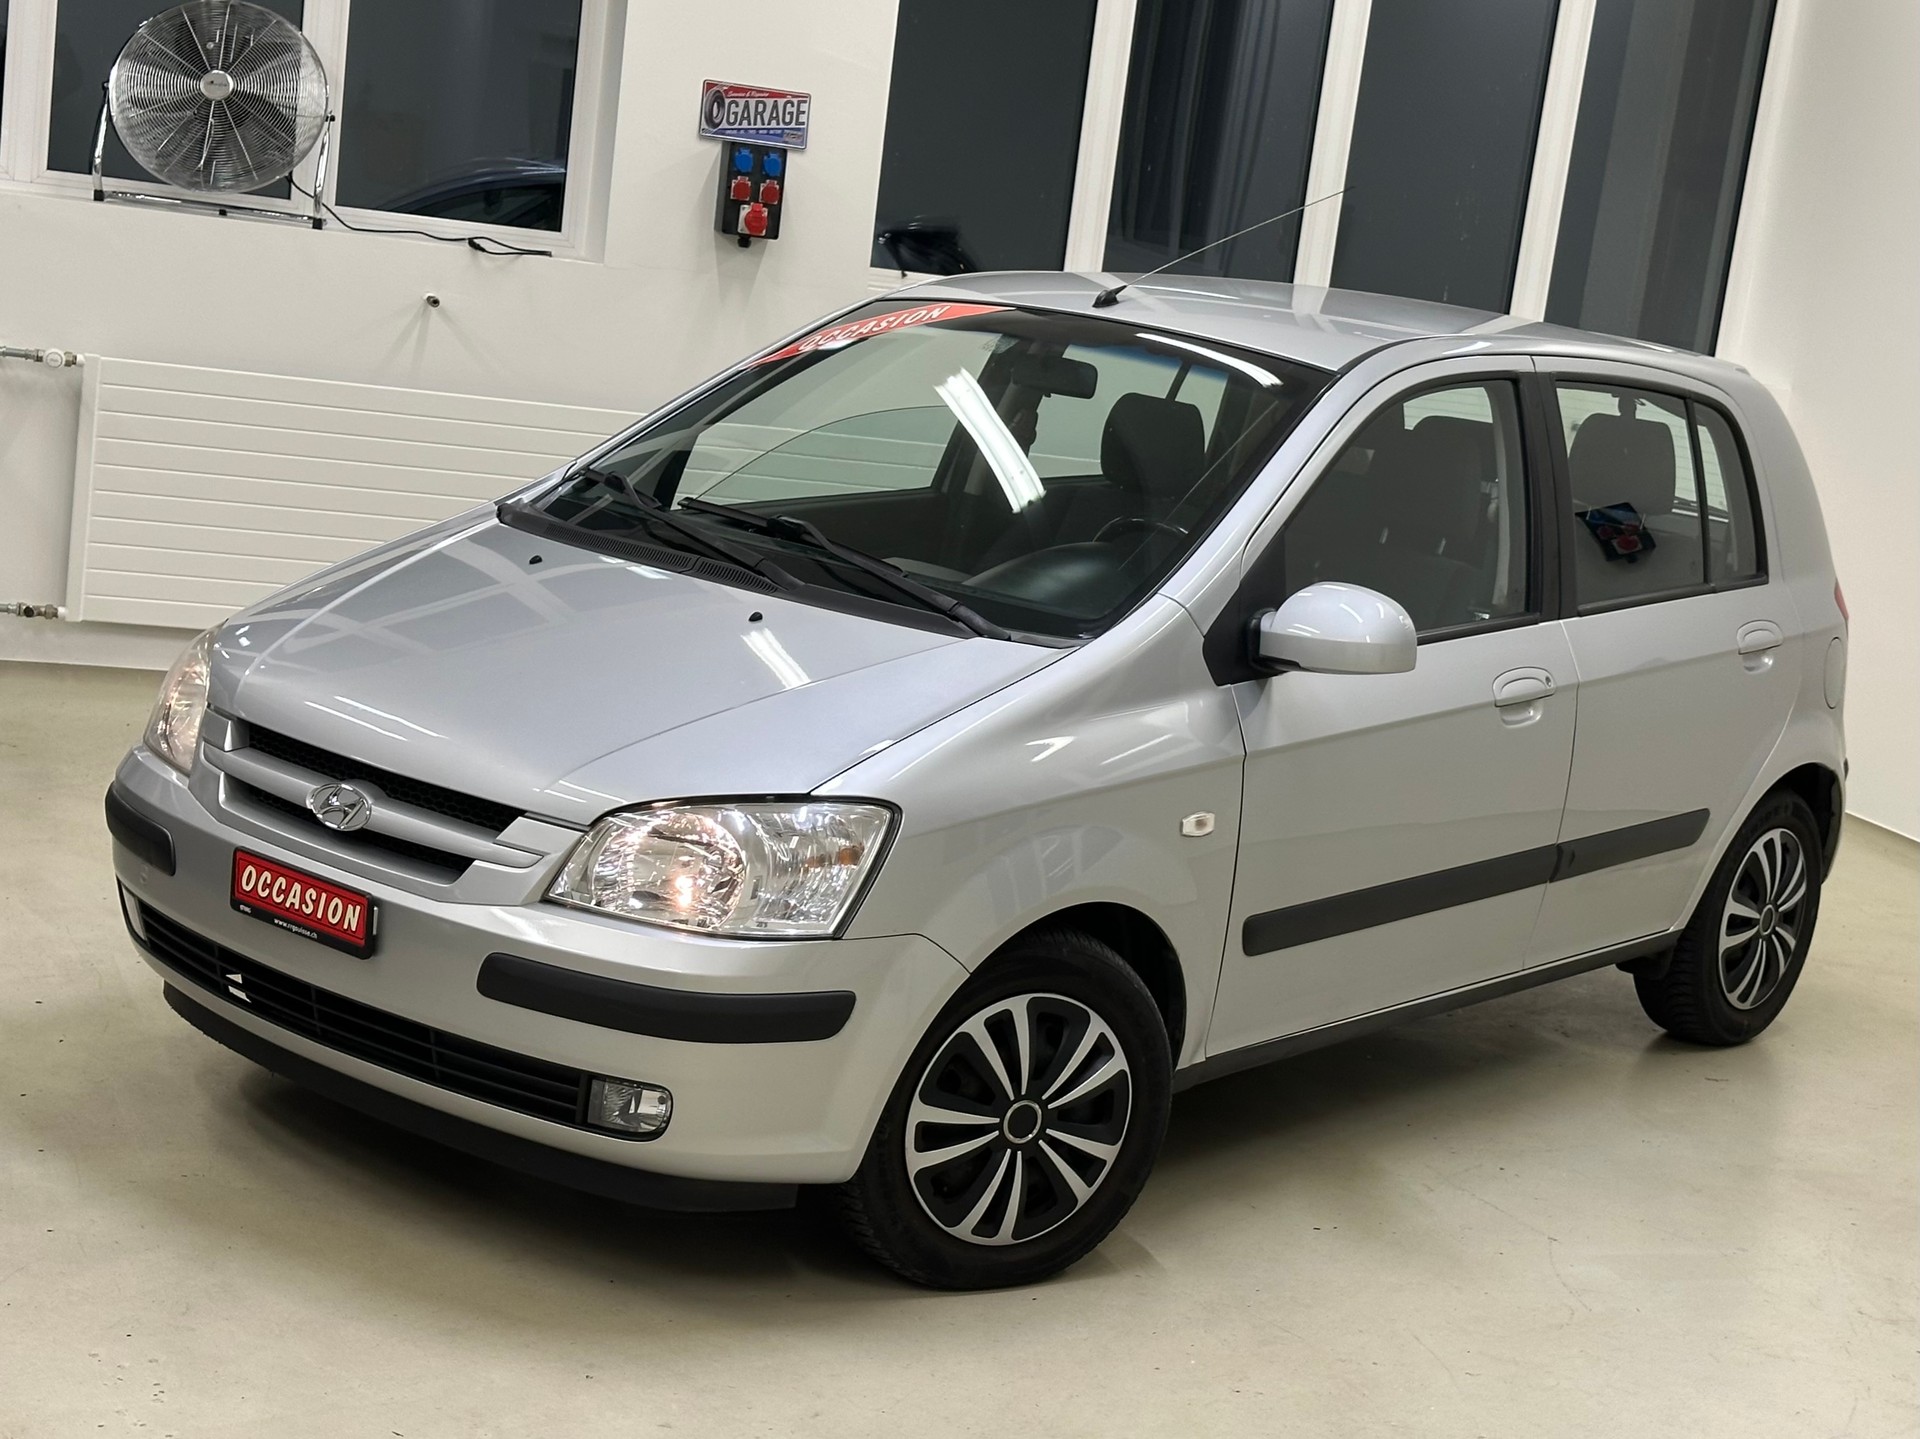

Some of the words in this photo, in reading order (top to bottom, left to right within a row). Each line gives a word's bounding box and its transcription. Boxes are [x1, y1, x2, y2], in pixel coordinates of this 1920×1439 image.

[726, 99, 808, 127] GARAGE
[799, 305, 951, 350] OCCASION
[241, 865, 361, 932] OCCASION
